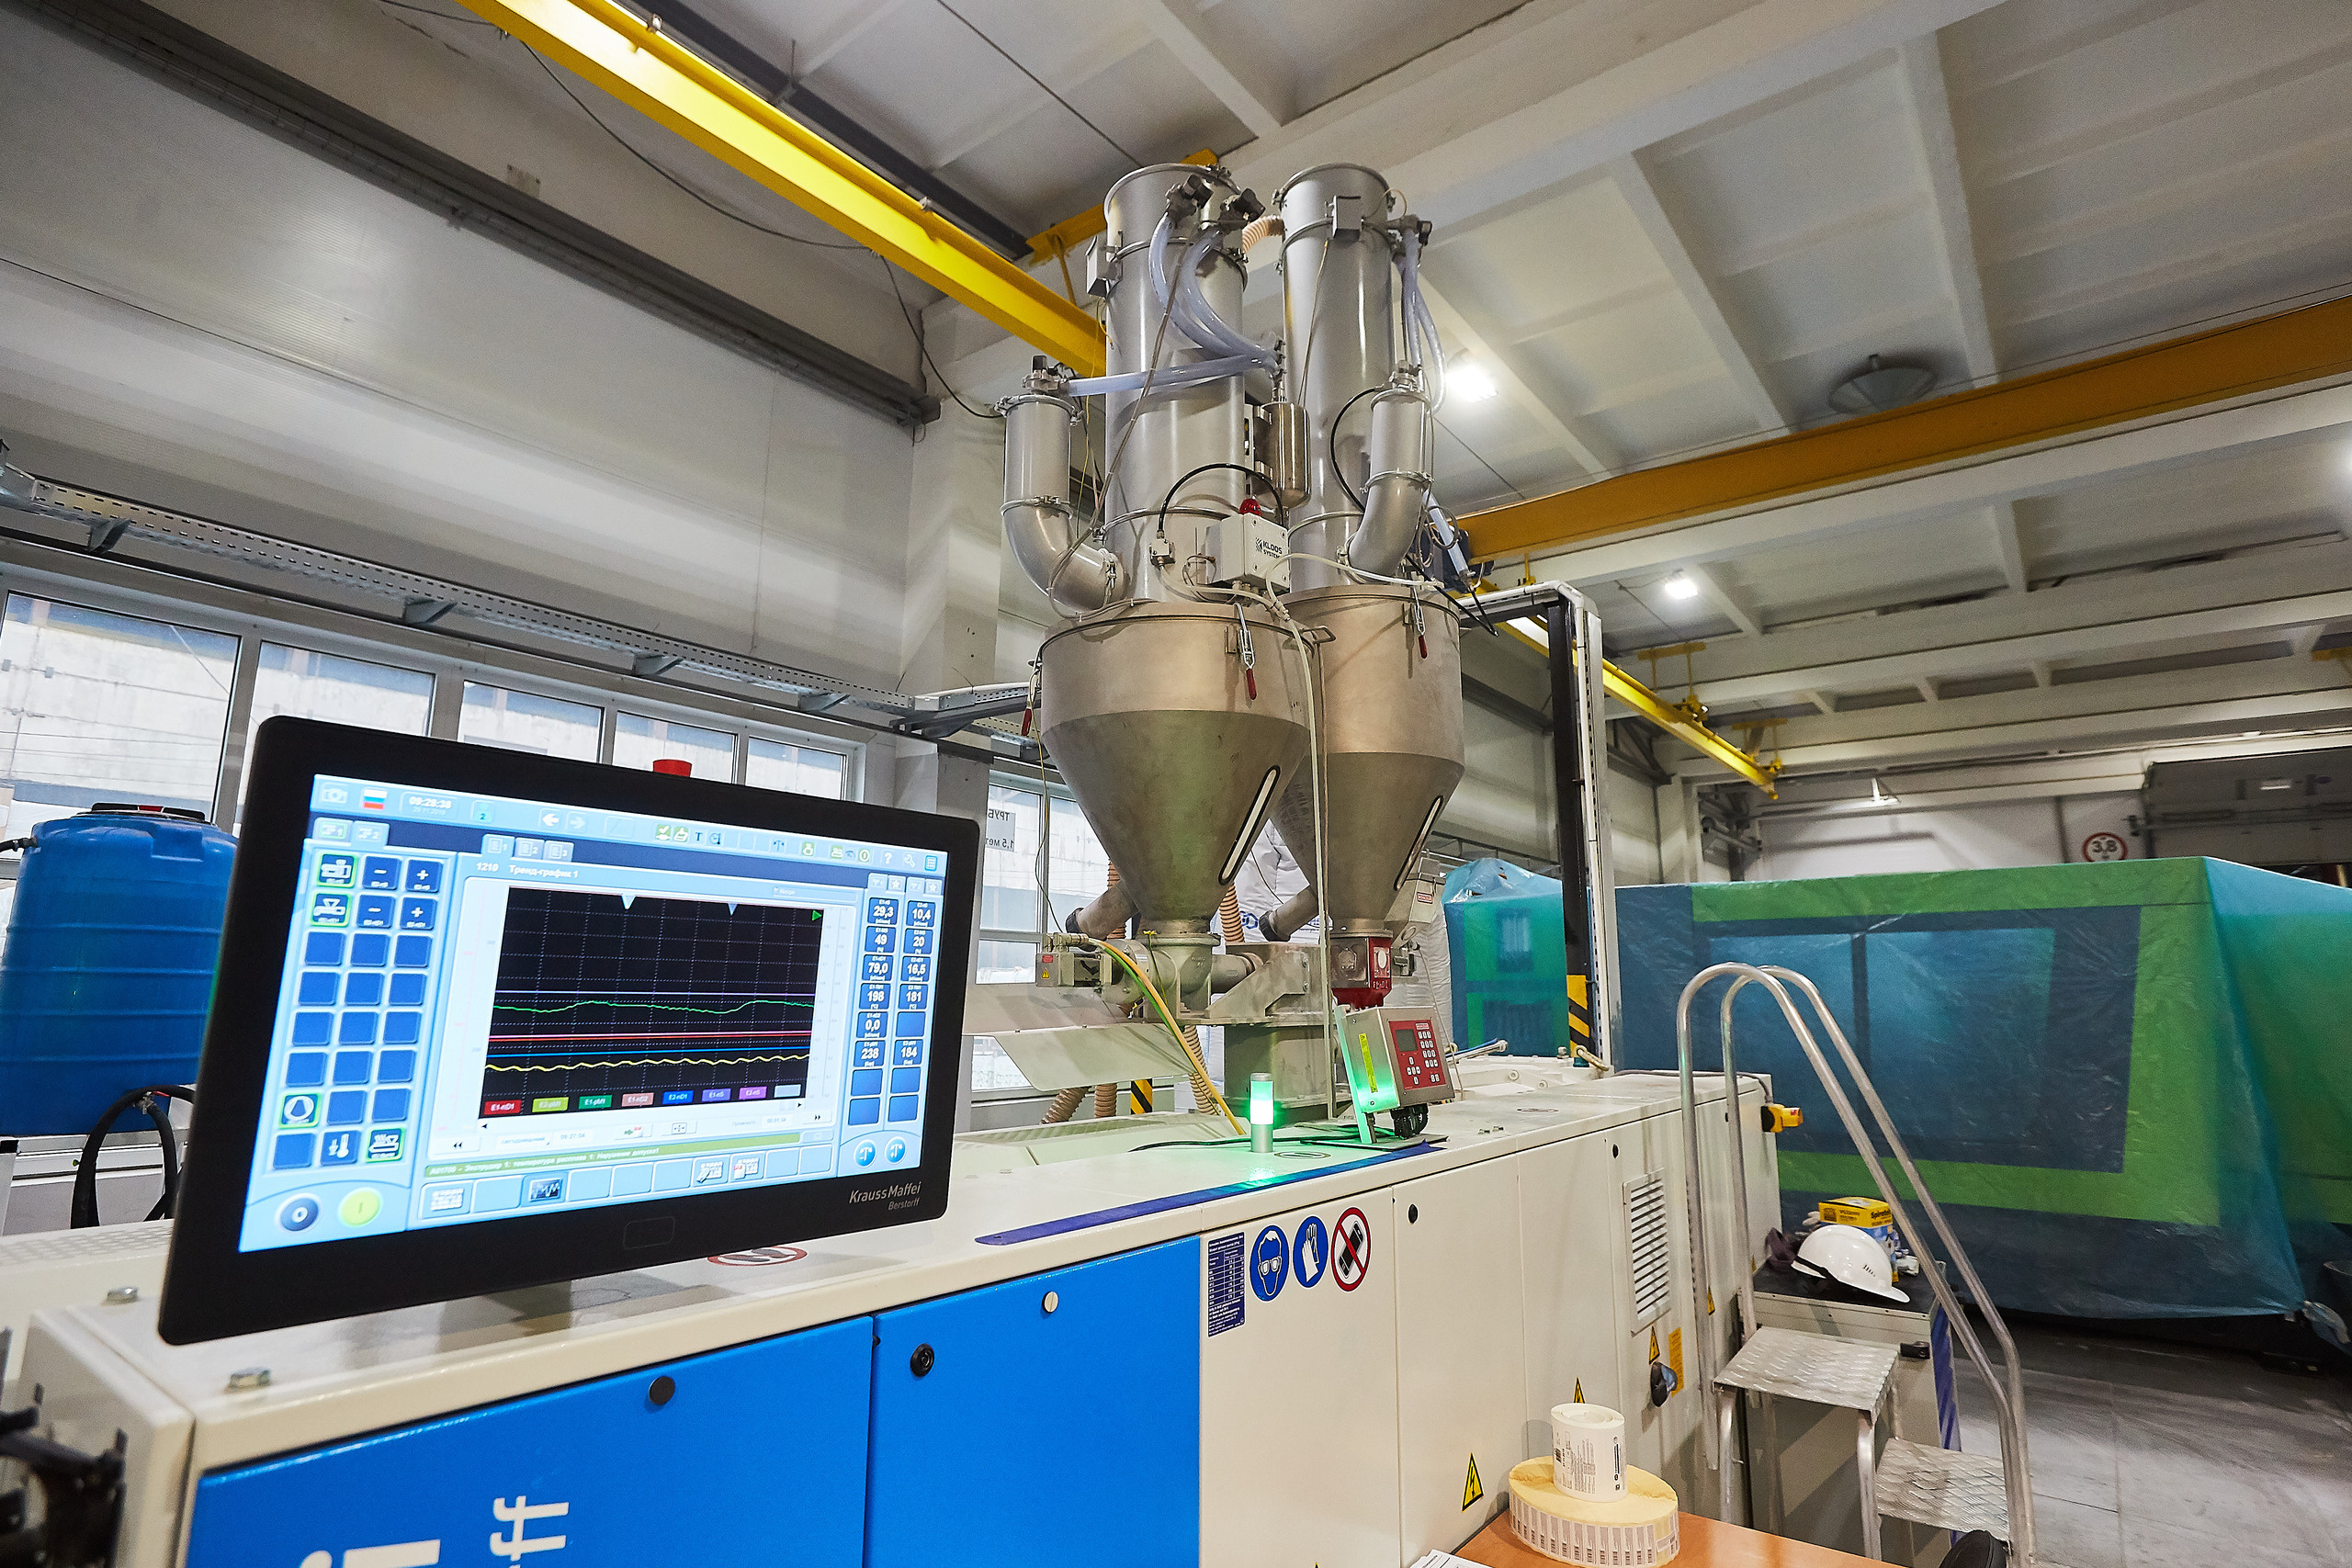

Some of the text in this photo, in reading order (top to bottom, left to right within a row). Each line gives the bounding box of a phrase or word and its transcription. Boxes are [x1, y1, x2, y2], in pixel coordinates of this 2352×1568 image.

[1263, 549, 1281, 558] SYSTEM
[873, 906, 894, 919] 29,3
[912, 908, 931, 921] 10,4
[875, 934, 888, 945] 49
[912, 936, 925, 947] 20
[868, 962, 888, 975] 79,0
[907, 964, 926, 976] 16,5
[867, 991, 885, 1002] 198
[906, 991, 922, 1002] 181
[865, 1020, 880, 1032] 0,0
[861, 1047, 879, 1060] 238
[900, 1046, 918, 1058] 184
[888, 1198, 920, 1211] Berstorff
